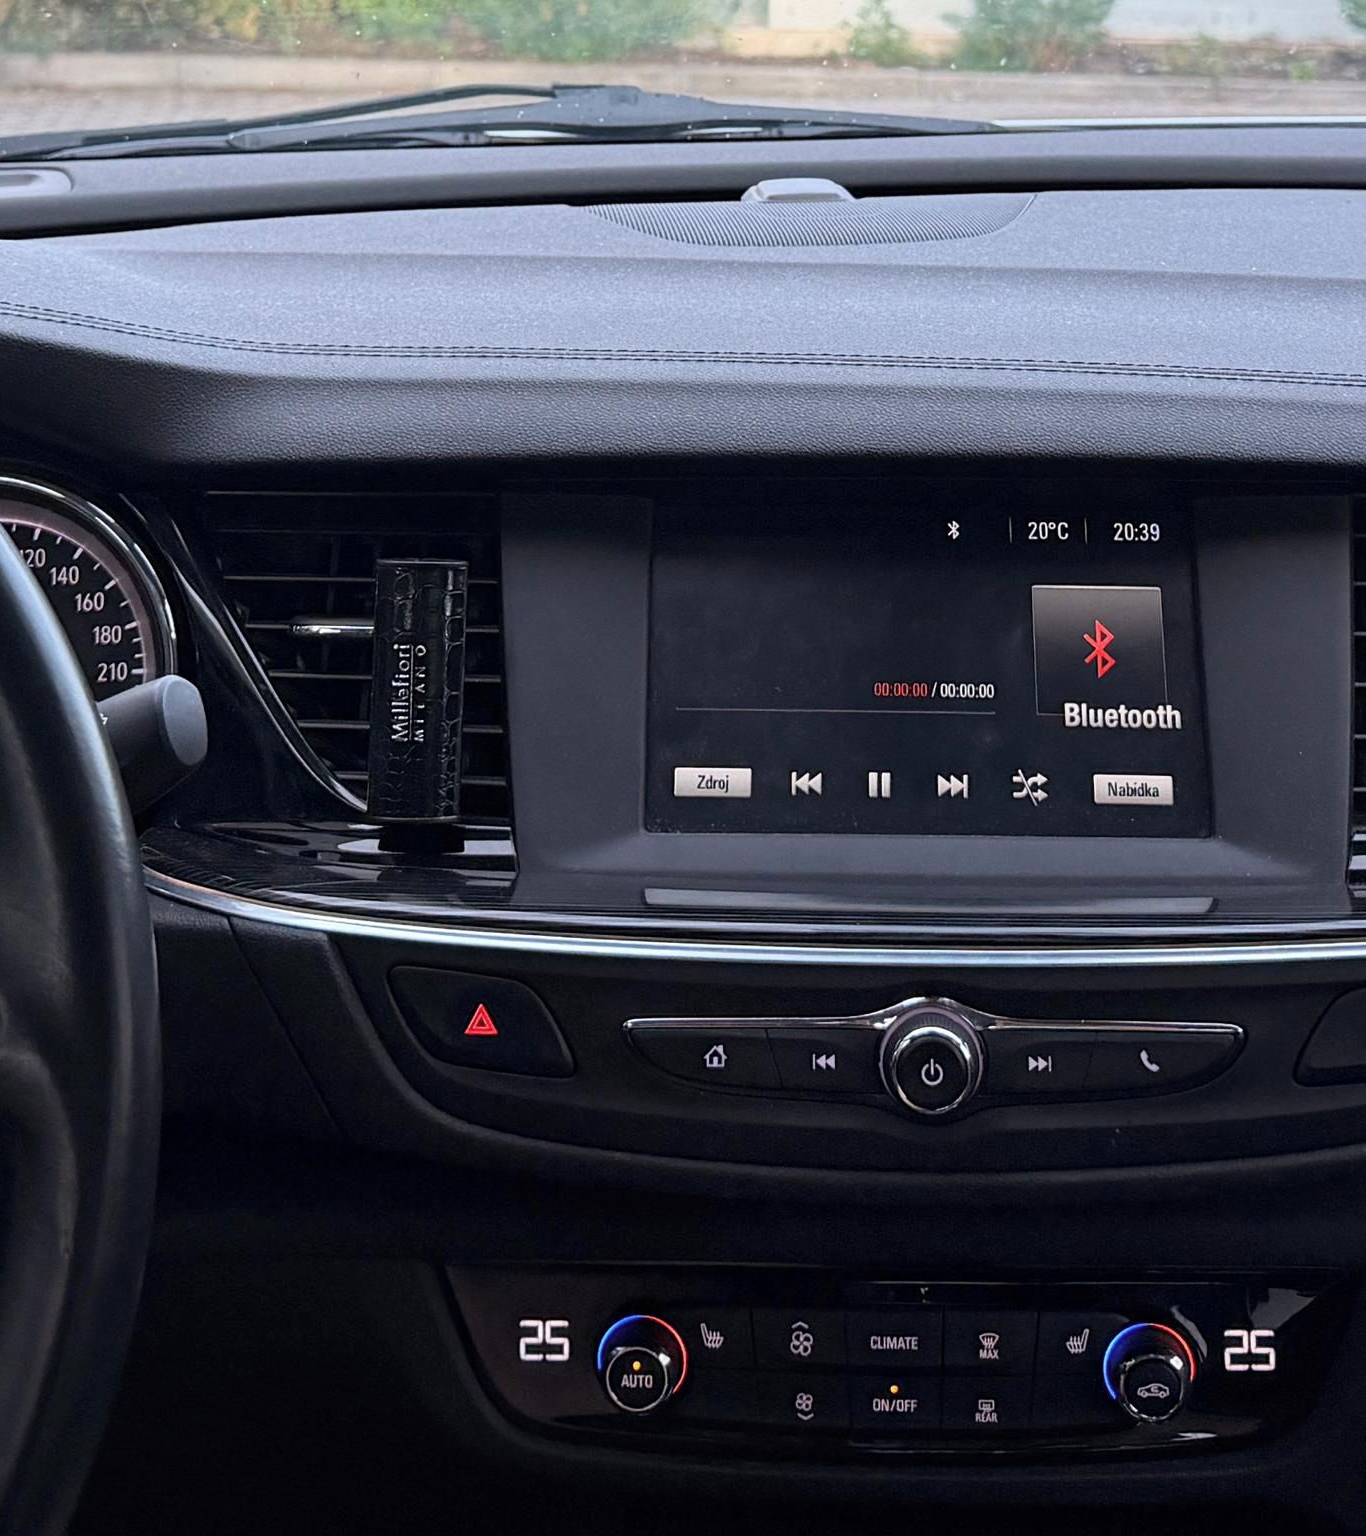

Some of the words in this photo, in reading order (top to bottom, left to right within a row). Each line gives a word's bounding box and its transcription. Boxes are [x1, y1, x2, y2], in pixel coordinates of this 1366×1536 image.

[1028, 521, 1069, 540] 20°C
[1113, 522, 1160, 541] 20:39
[49, 565, 80, 586] 140
[75, 591, 105, 612] 160
[92, 625, 122, 645] 180
[96, 662, 128, 682] 210
[391, 644, 410, 741] Millefiori
[874, 682, 928, 697] 00:00:00
[940, 683, 995, 698] 00:00:00
[1064, 702, 1182, 730] Bluetooth
[697, 774, 729, 793] Zdroj
[519, 1319, 570, 1362] 25
[870, 1335, 919, 1351] CLIMATE
[1223, 1329, 1276, 1372] 25
[979, 1349, 999, 1360] MAX
[621, 1374, 653, 1389] AUTO
[872, 1398, 918, 1413] ON/OFF
[975, 1412, 999, 1424] REAR
